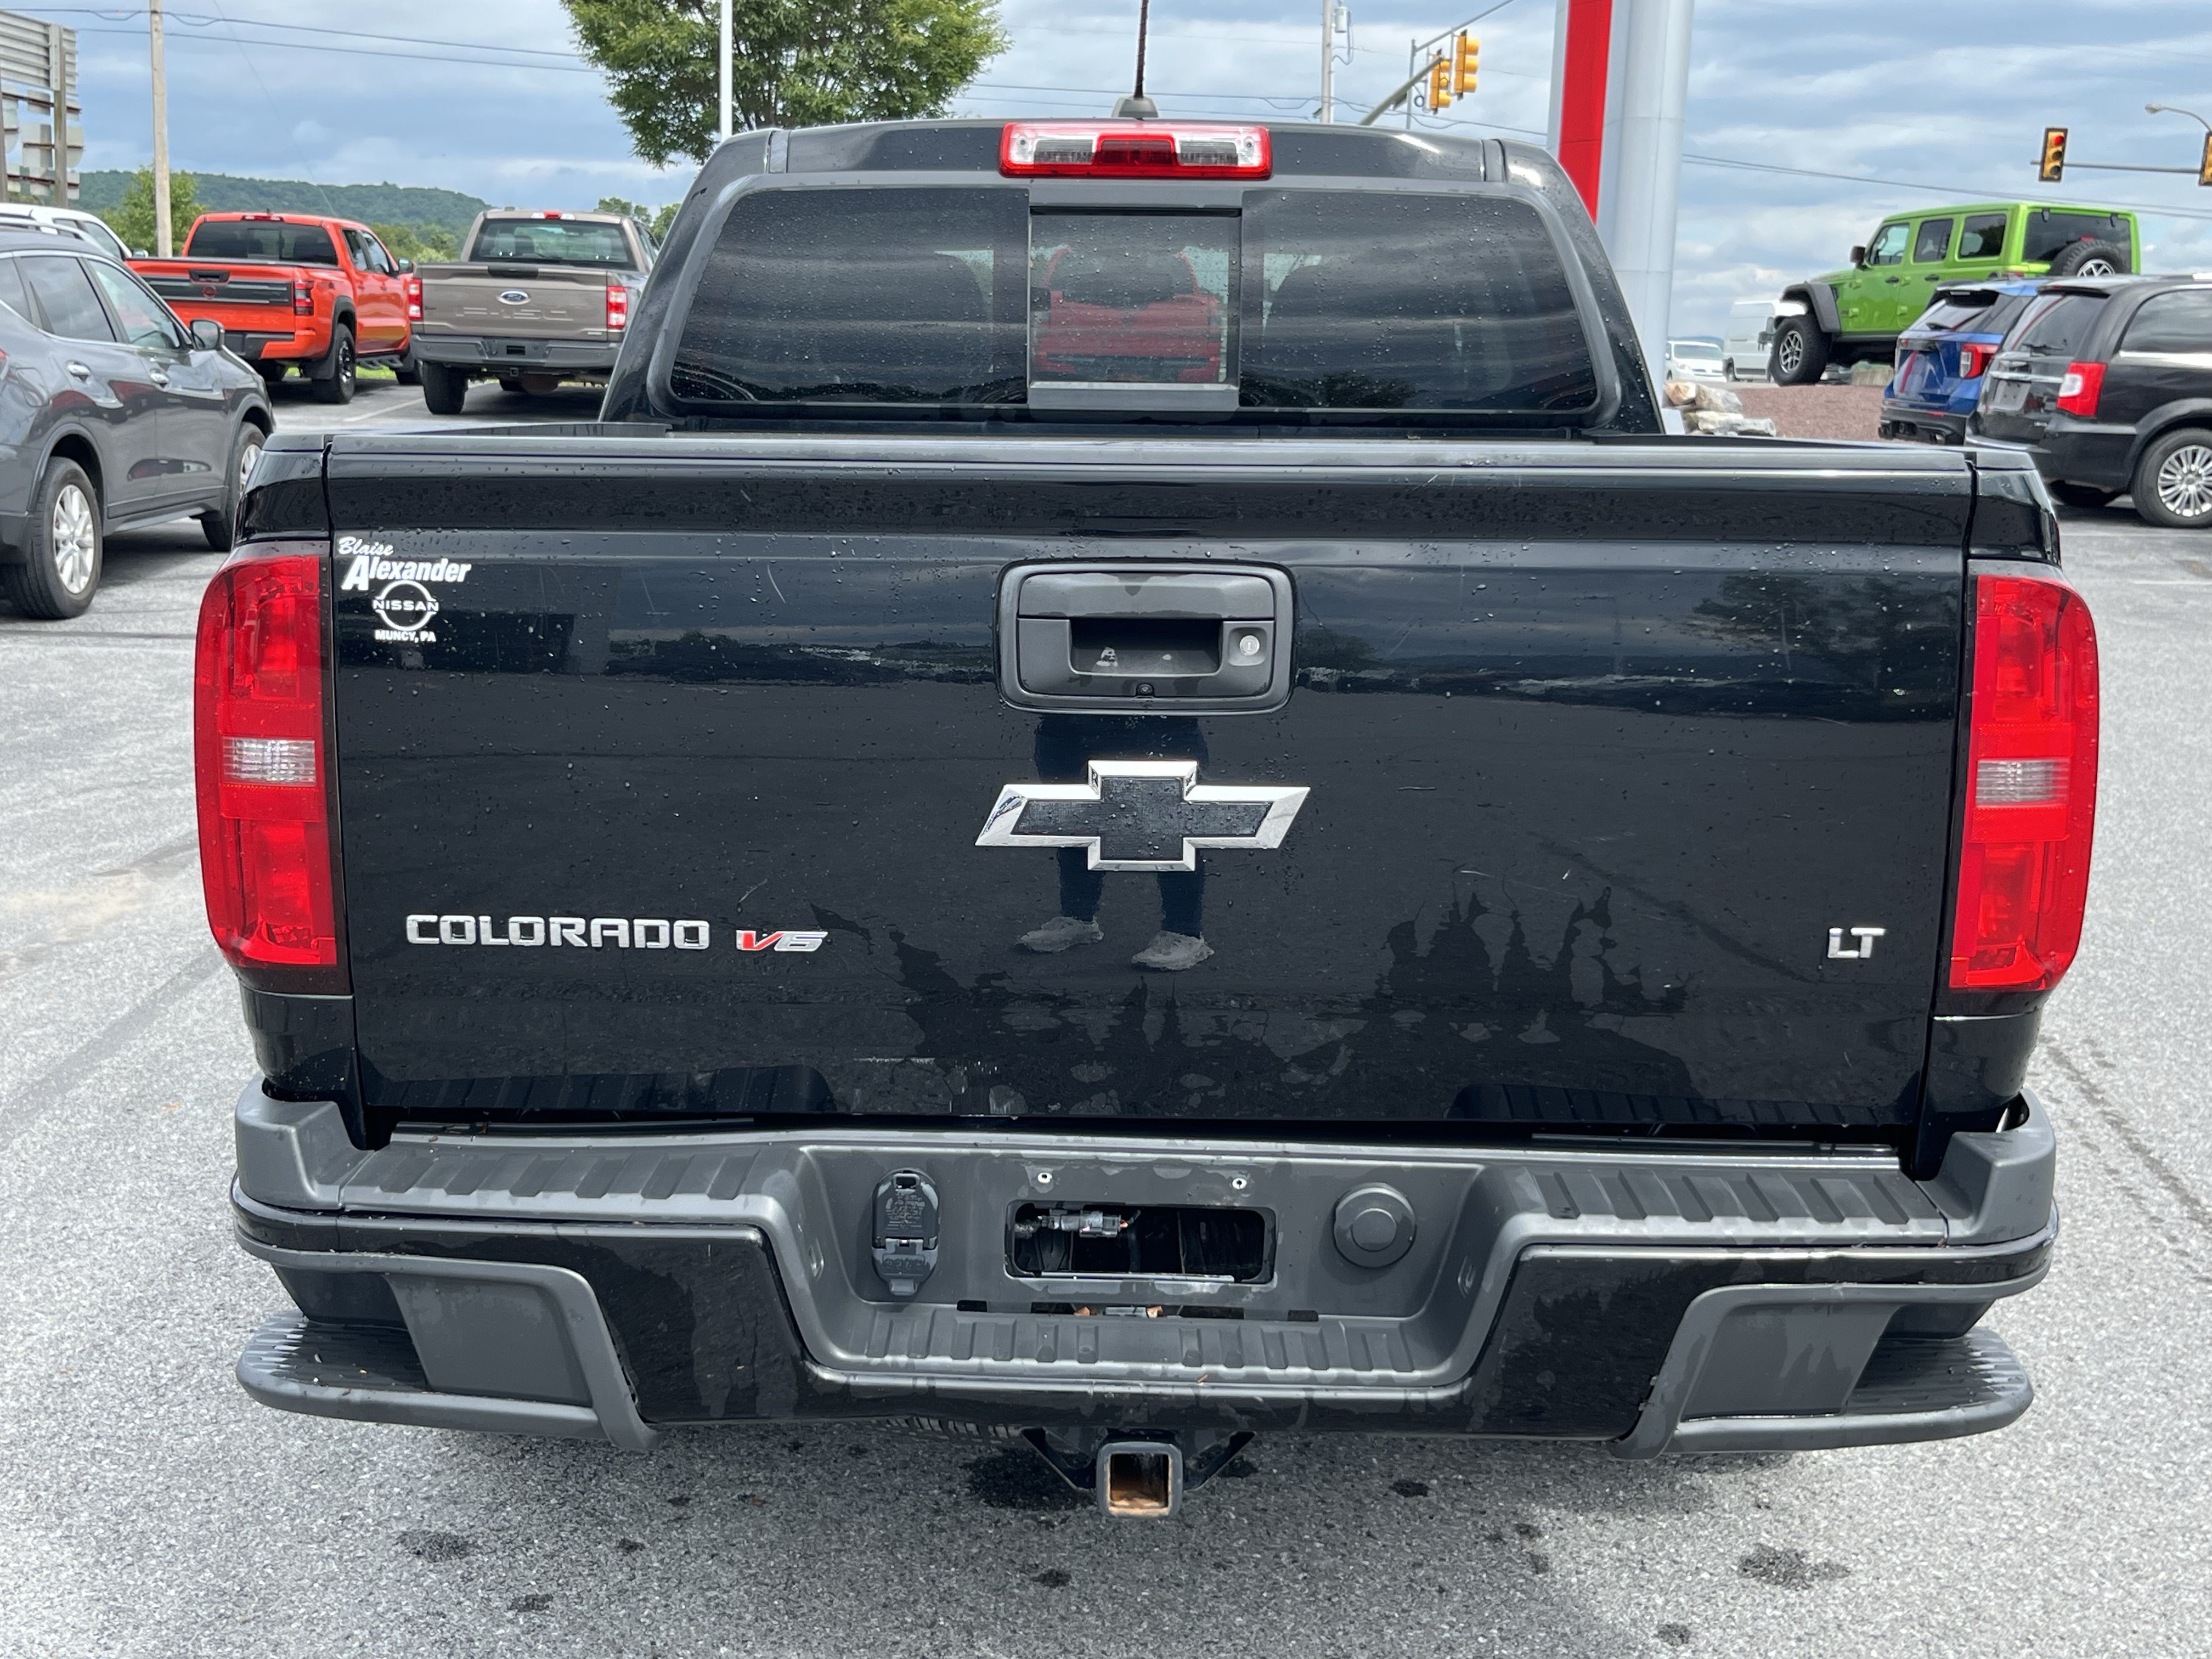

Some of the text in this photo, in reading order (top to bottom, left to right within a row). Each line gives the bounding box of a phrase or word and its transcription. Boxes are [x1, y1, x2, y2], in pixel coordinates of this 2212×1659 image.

[338, 536, 394, 556] Blaise
[341, 556, 472, 591] Alexander
[373, 599, 439, 611] NISSAN
[374, 629, 437, 644] MUNCY, PA
[406, 914, 828, 952] COLORADO V6
[1827, 927, 1887, 958] LT
